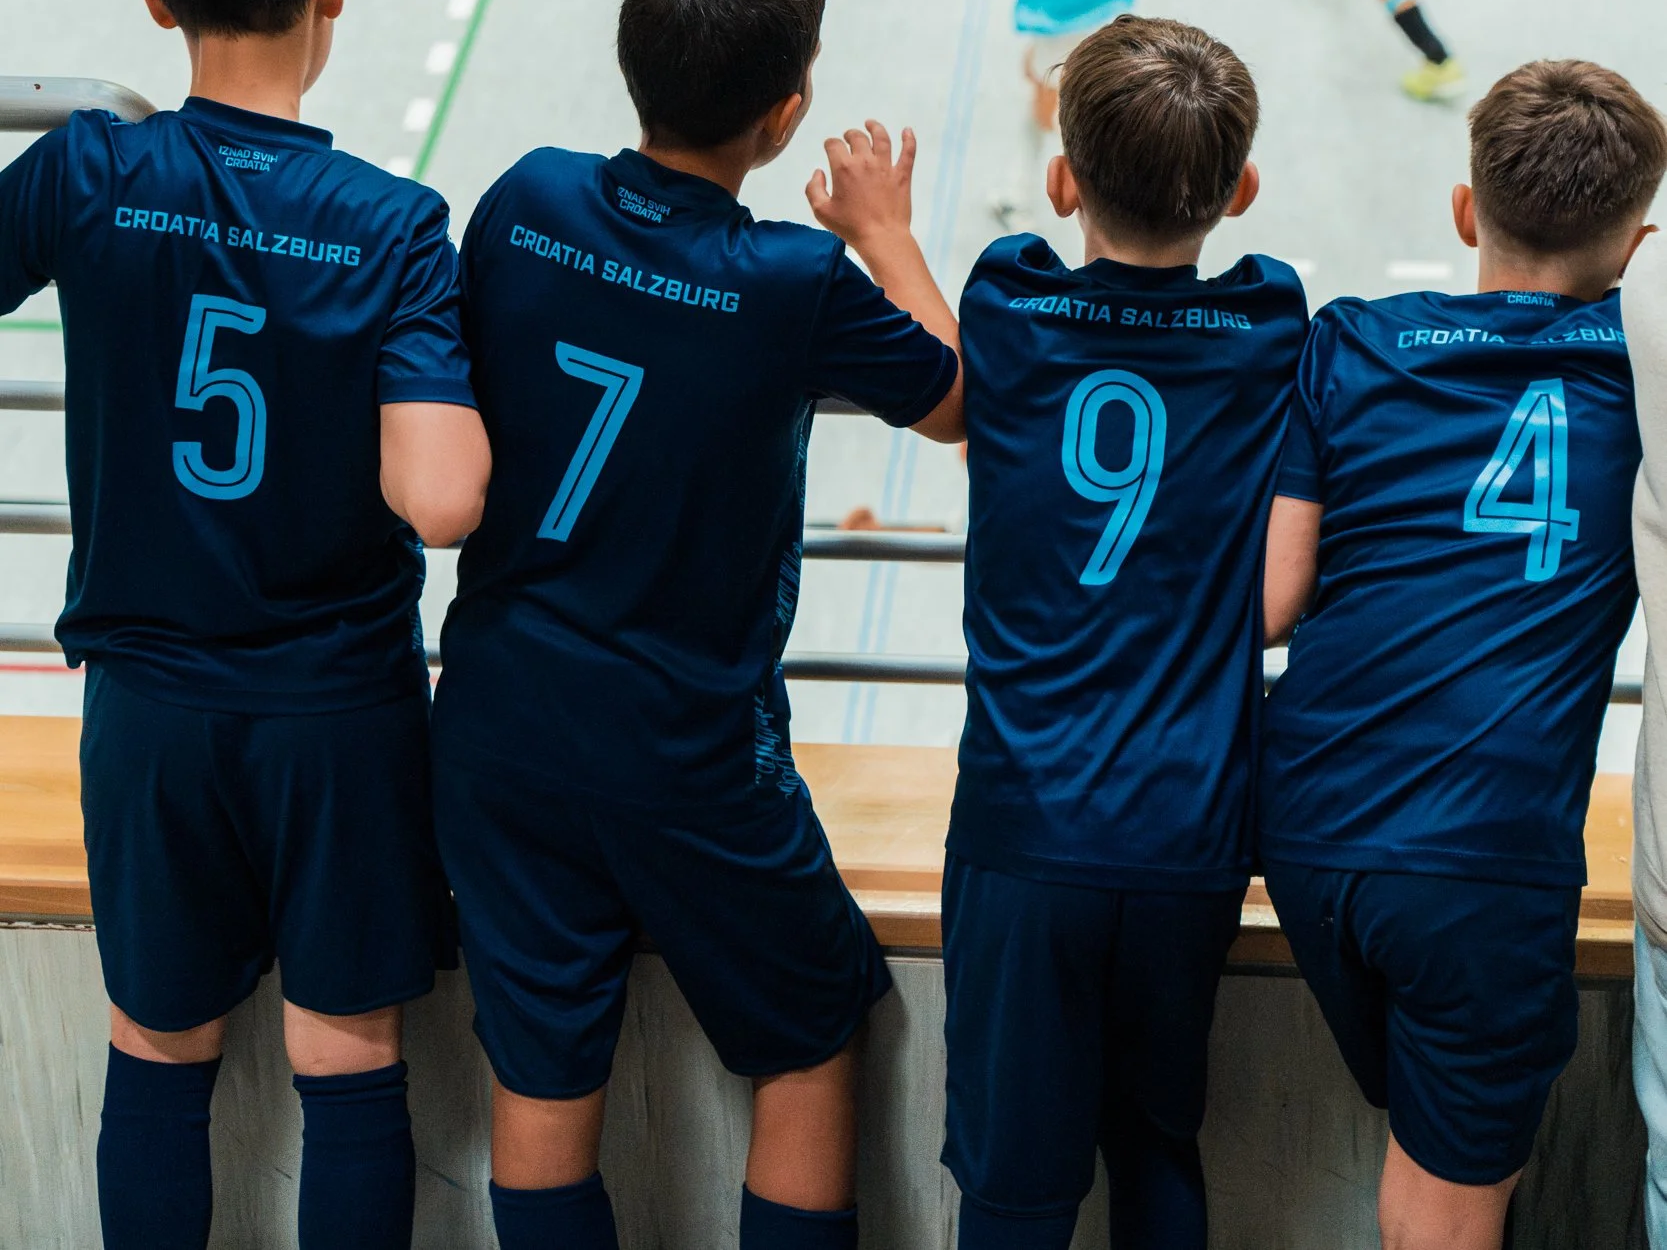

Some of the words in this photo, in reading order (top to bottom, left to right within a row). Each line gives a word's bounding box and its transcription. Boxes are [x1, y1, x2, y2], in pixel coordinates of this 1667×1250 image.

[219, 145, 251, 158] IZNAD
[252, 151, 279, 163] SVIH
[225, 157, 271, 171] CROATIA
[619, 198, 662, 223] CROATIA
[648, 201, 671, 216] SVIH
[115, 206, 220, 243] CROATIA
[227, 226, 361, 266] SALZBURG
[509, 224, 595, 275] CROATIA
[602, 260, 741, 312] SALZBURG
[1008, 296, 1111, 323] CROATIA
[1120, 308, 1252, 330] SALZBURG
[1507, 295, 1555, 308] CROATIA
[1397, 328, 1505, 349] CROATIA
[172, 293, 267, 501] 5
[536, 341, 645, 543] 7
[1060, 369, 1168, 586] 9
[1462, 377, 1580, 583] 4
